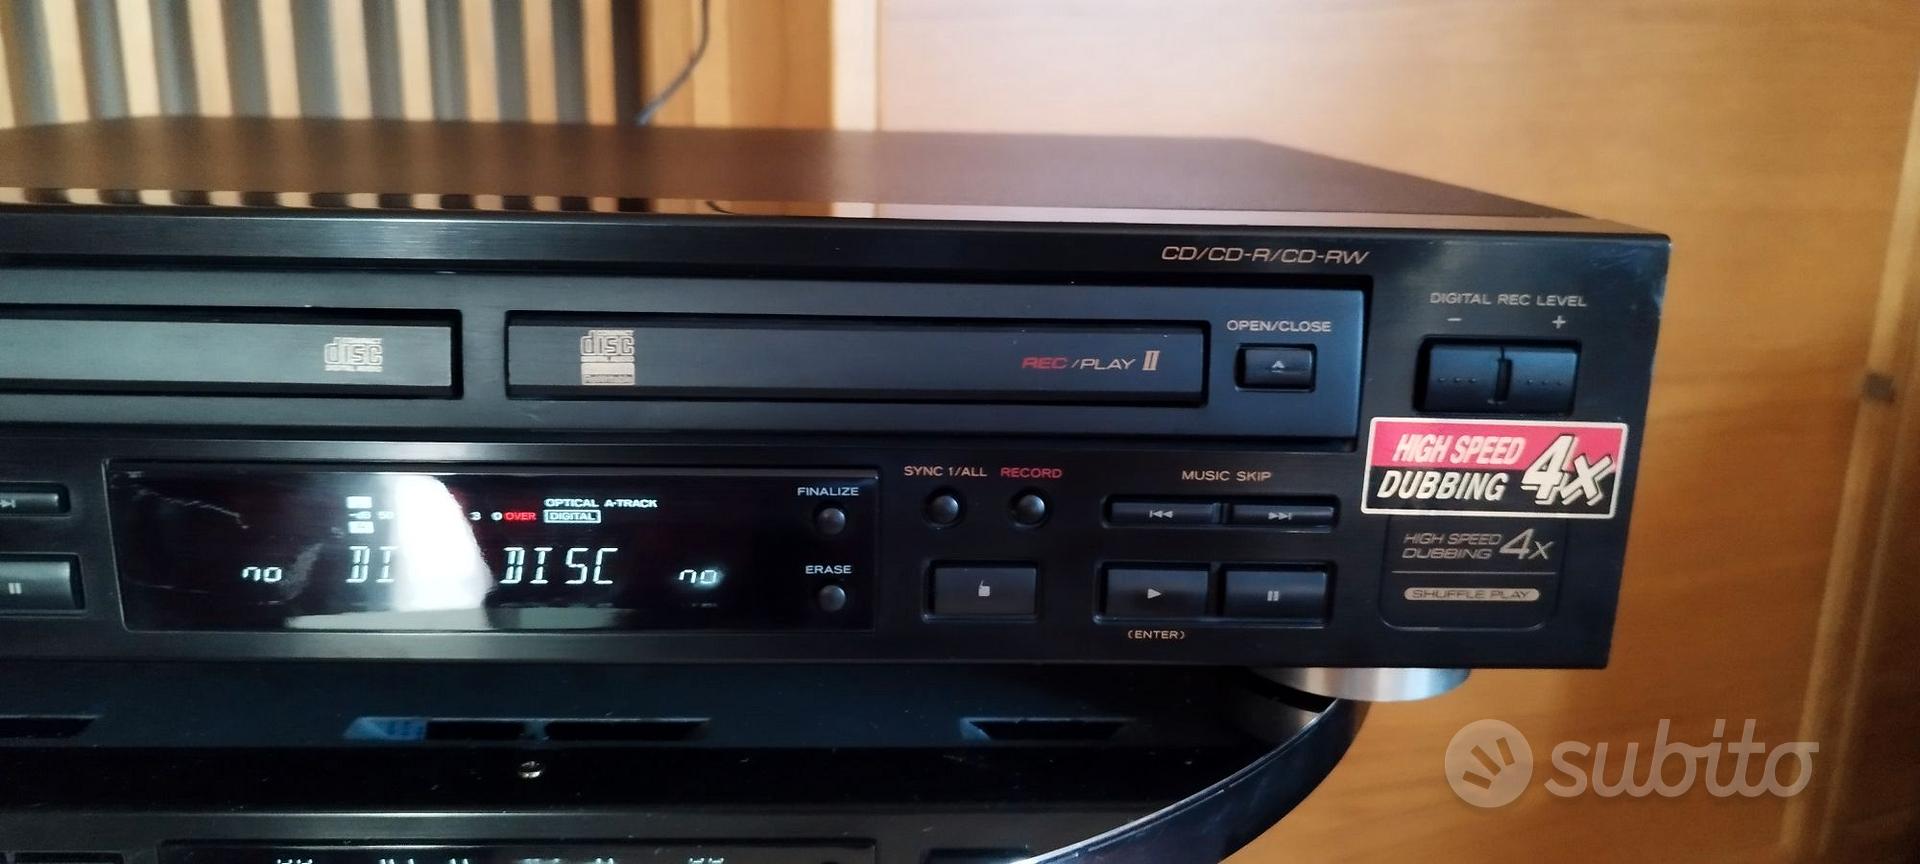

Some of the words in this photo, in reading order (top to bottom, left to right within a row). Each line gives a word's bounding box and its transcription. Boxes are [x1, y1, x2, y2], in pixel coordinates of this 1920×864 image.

[1161, 246, 1369, 266] CD/CD-R/CD-RW
[1430, 292, 1491, 305] DIGITAL
[1498, 293, 1530, 306] REC
[1537, 294, 1587, 307] LEVEL
[1226, 319, 1332, 333] OPEN/CLOSE
[1392, 434, 1449, 462] HIGH
[1450, 435, 1527, 465] SPEED
[904, 466, 945, 477] SYNC
[948, 466, 988, 478] 1/ALL
[1000, 467, 1063, 479] RECORD
[1181, 469, 1230, 482] MUSIC
[1236, 470, 1273, 482] SKIP
[1377, 470, 1509, 501] DUBBING
[796, 486, 860, 498] FINALIZE
[544, 498, 600, 508] OPTICAL
[603, 499, 658, 509] A-TRACK
[504, 511, 537, 521] OVER
[549, 511, 596, 522] DIGITAL
[1403, 533, 1443, 545] HIGH
[1446, 533, 1503, 545] SPEED
[1402, 548, 1493, 560] DUBBING
[499, 546, 619, 584] DISC
[805, 564, 852, 575] ERASE
[1411, 589, 1486, 600] SHUFFLE
[1489, 590, 1531, 600] PLAY
[1127, 629, 1185, 641] (ENTER)
